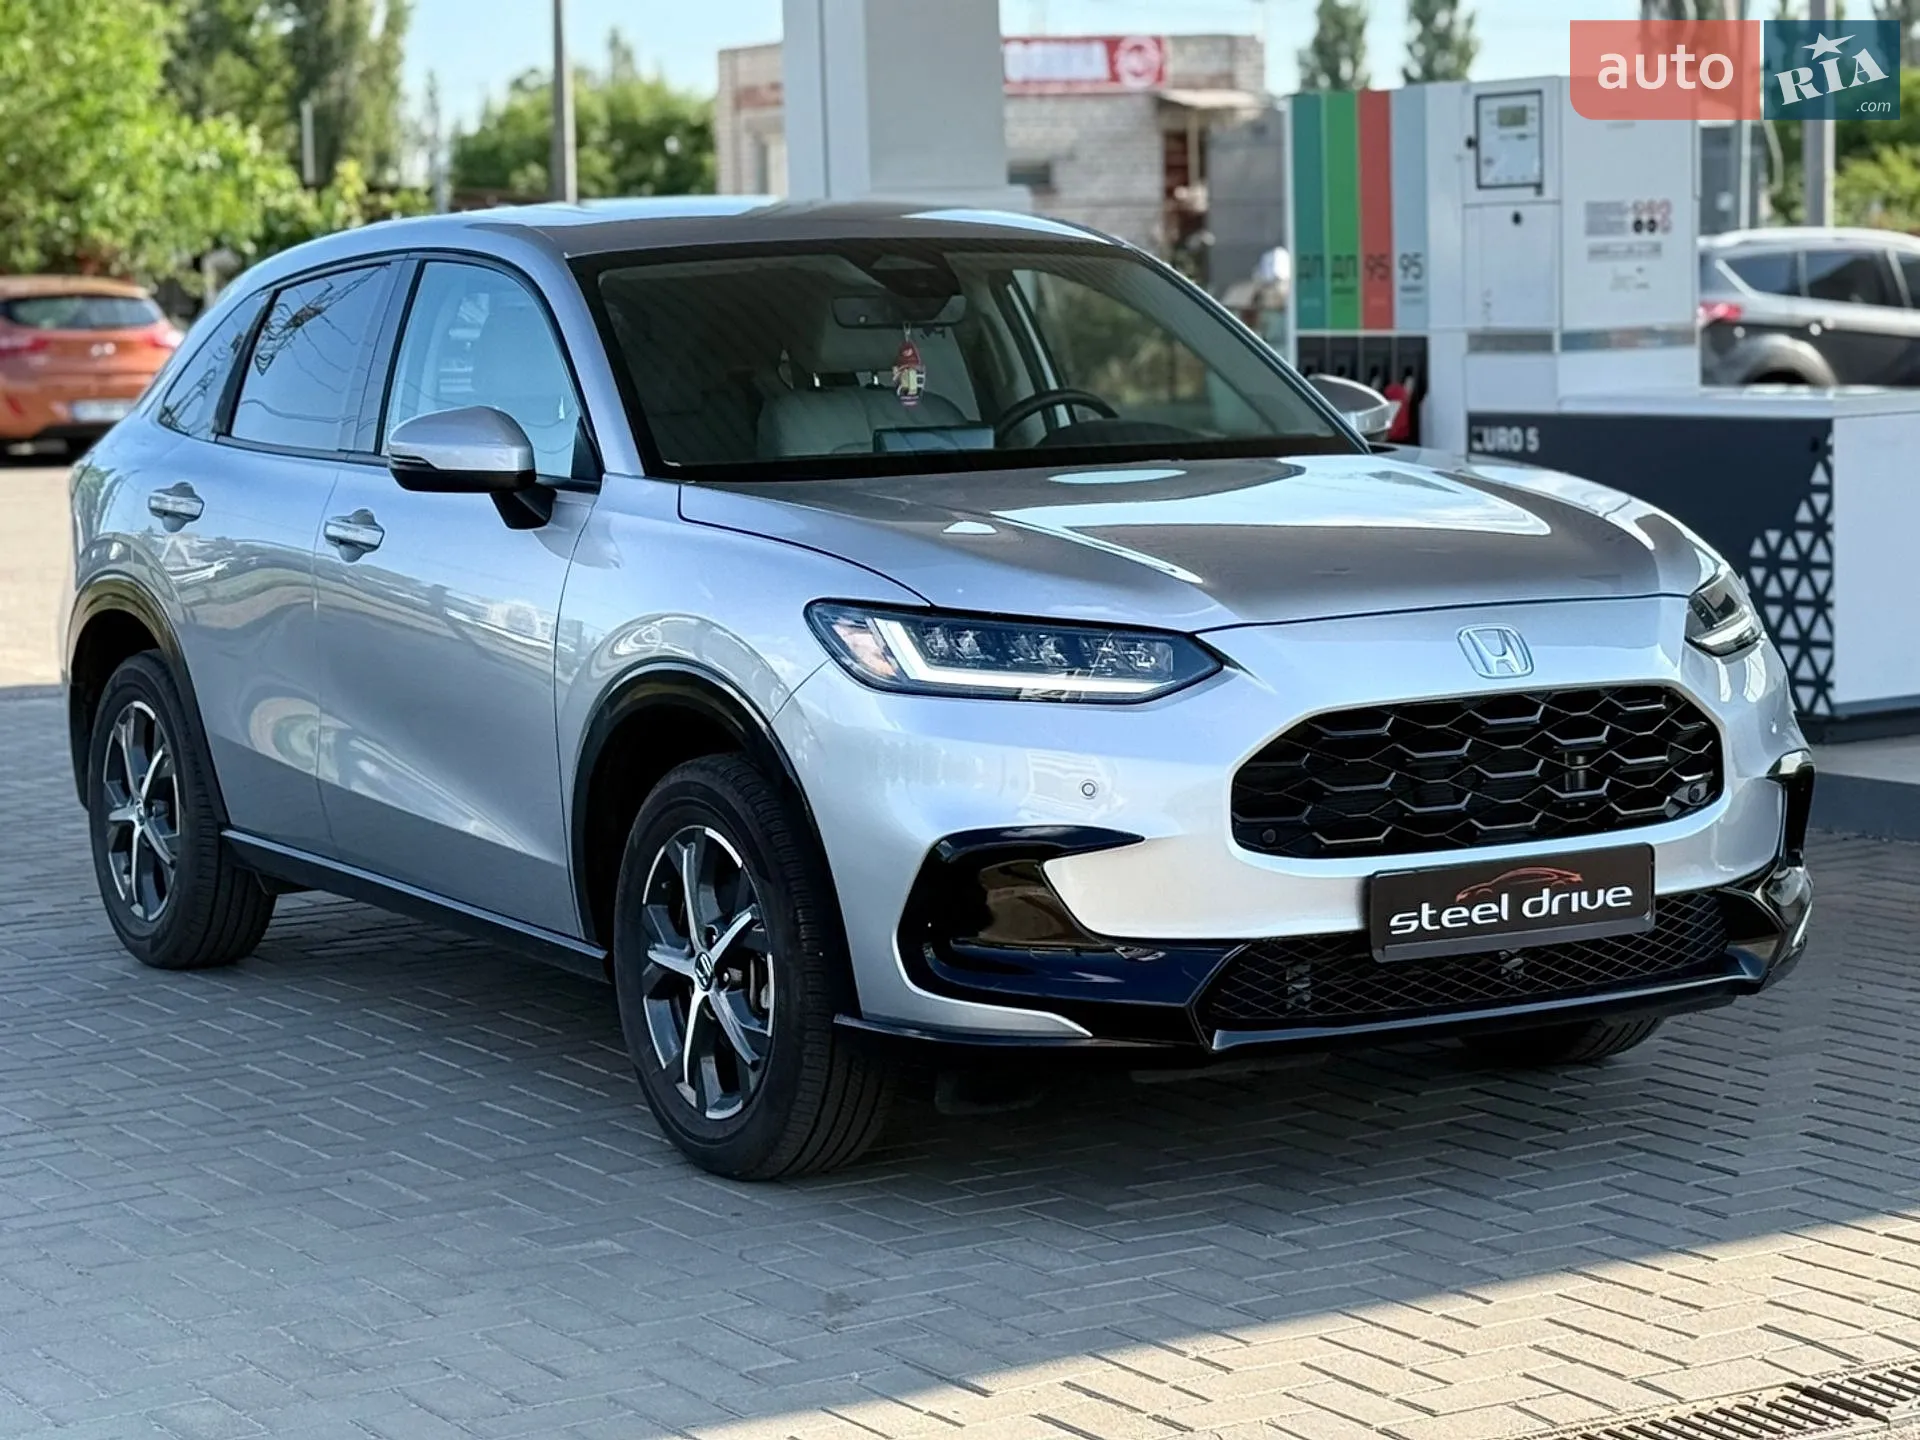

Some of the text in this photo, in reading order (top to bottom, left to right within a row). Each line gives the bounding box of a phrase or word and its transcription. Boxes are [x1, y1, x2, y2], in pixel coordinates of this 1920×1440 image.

[1399, 252, 1423, 280] 95
[1389, 885, 1633, 935] steel drive
